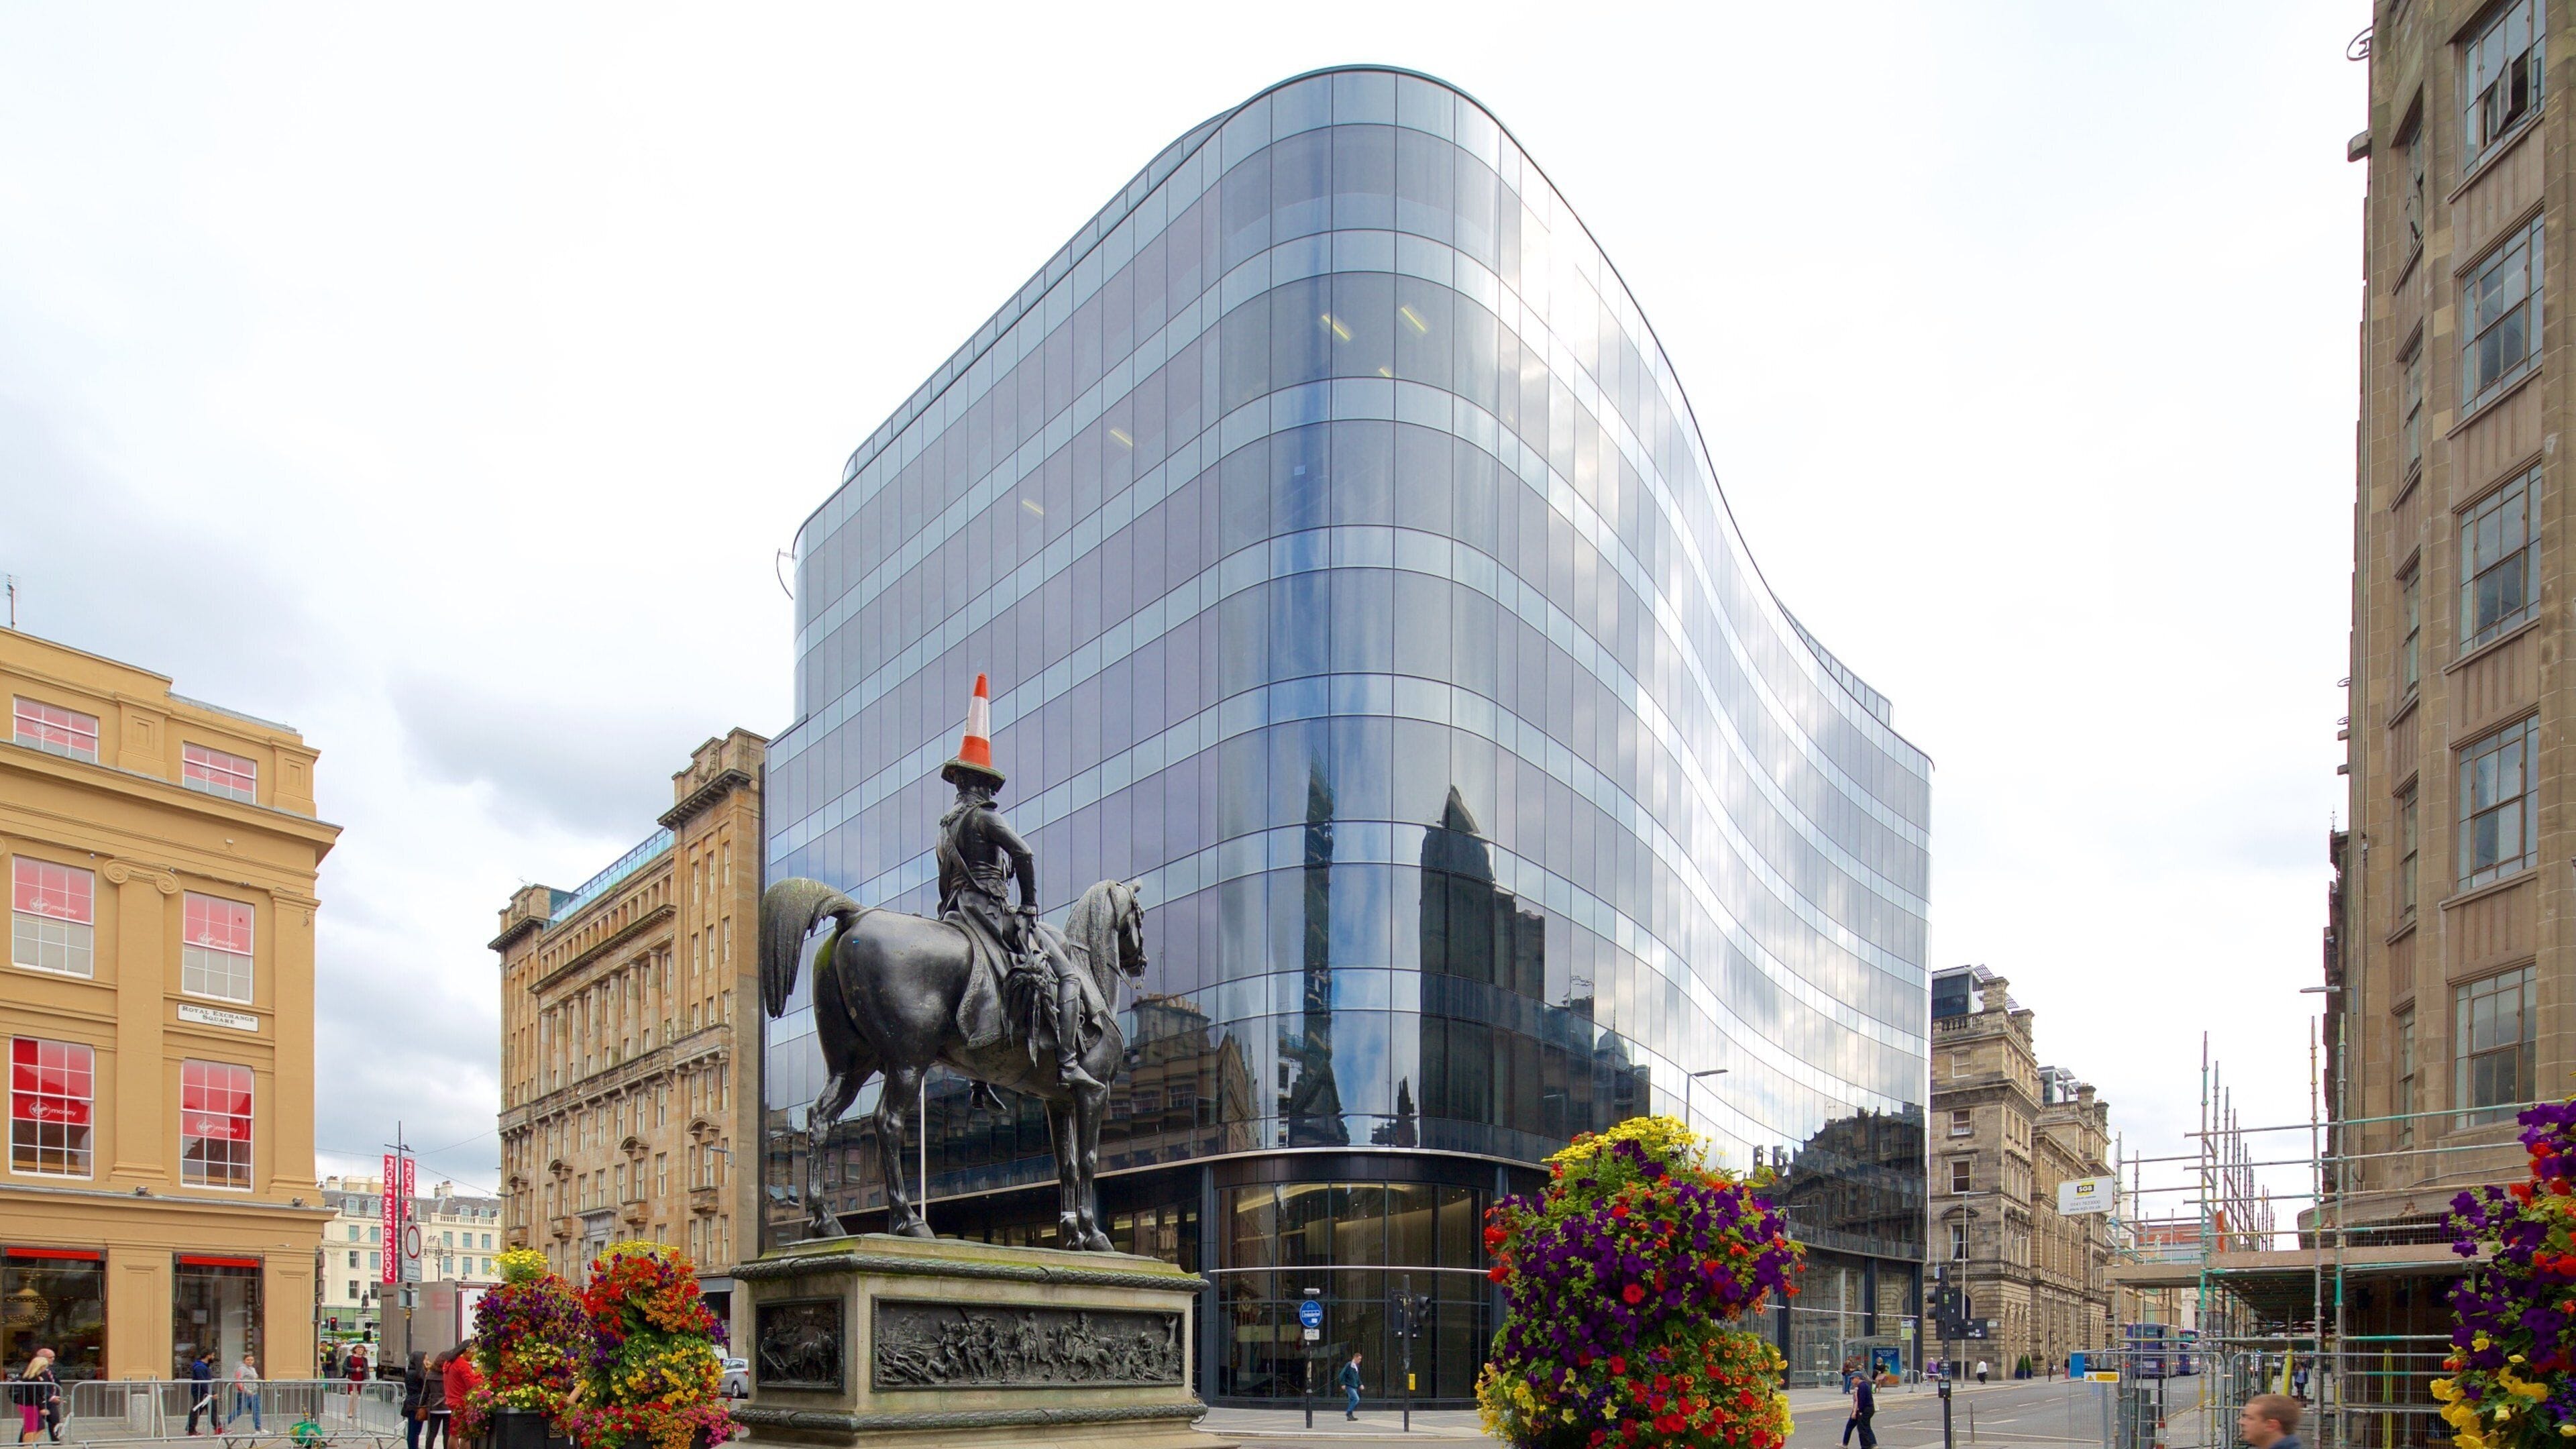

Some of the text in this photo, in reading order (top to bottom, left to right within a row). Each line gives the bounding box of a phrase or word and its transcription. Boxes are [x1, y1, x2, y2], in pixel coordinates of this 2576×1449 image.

[182, 1006, 254, 1022] ROYAL EXCHANGE
[203, 1014, 235, 1024] SQUARE
[405, 1161, 413, 1197] PEOPLE
[384, 1157, 394, 1280] PEOPLE MAKE GLASGOW
